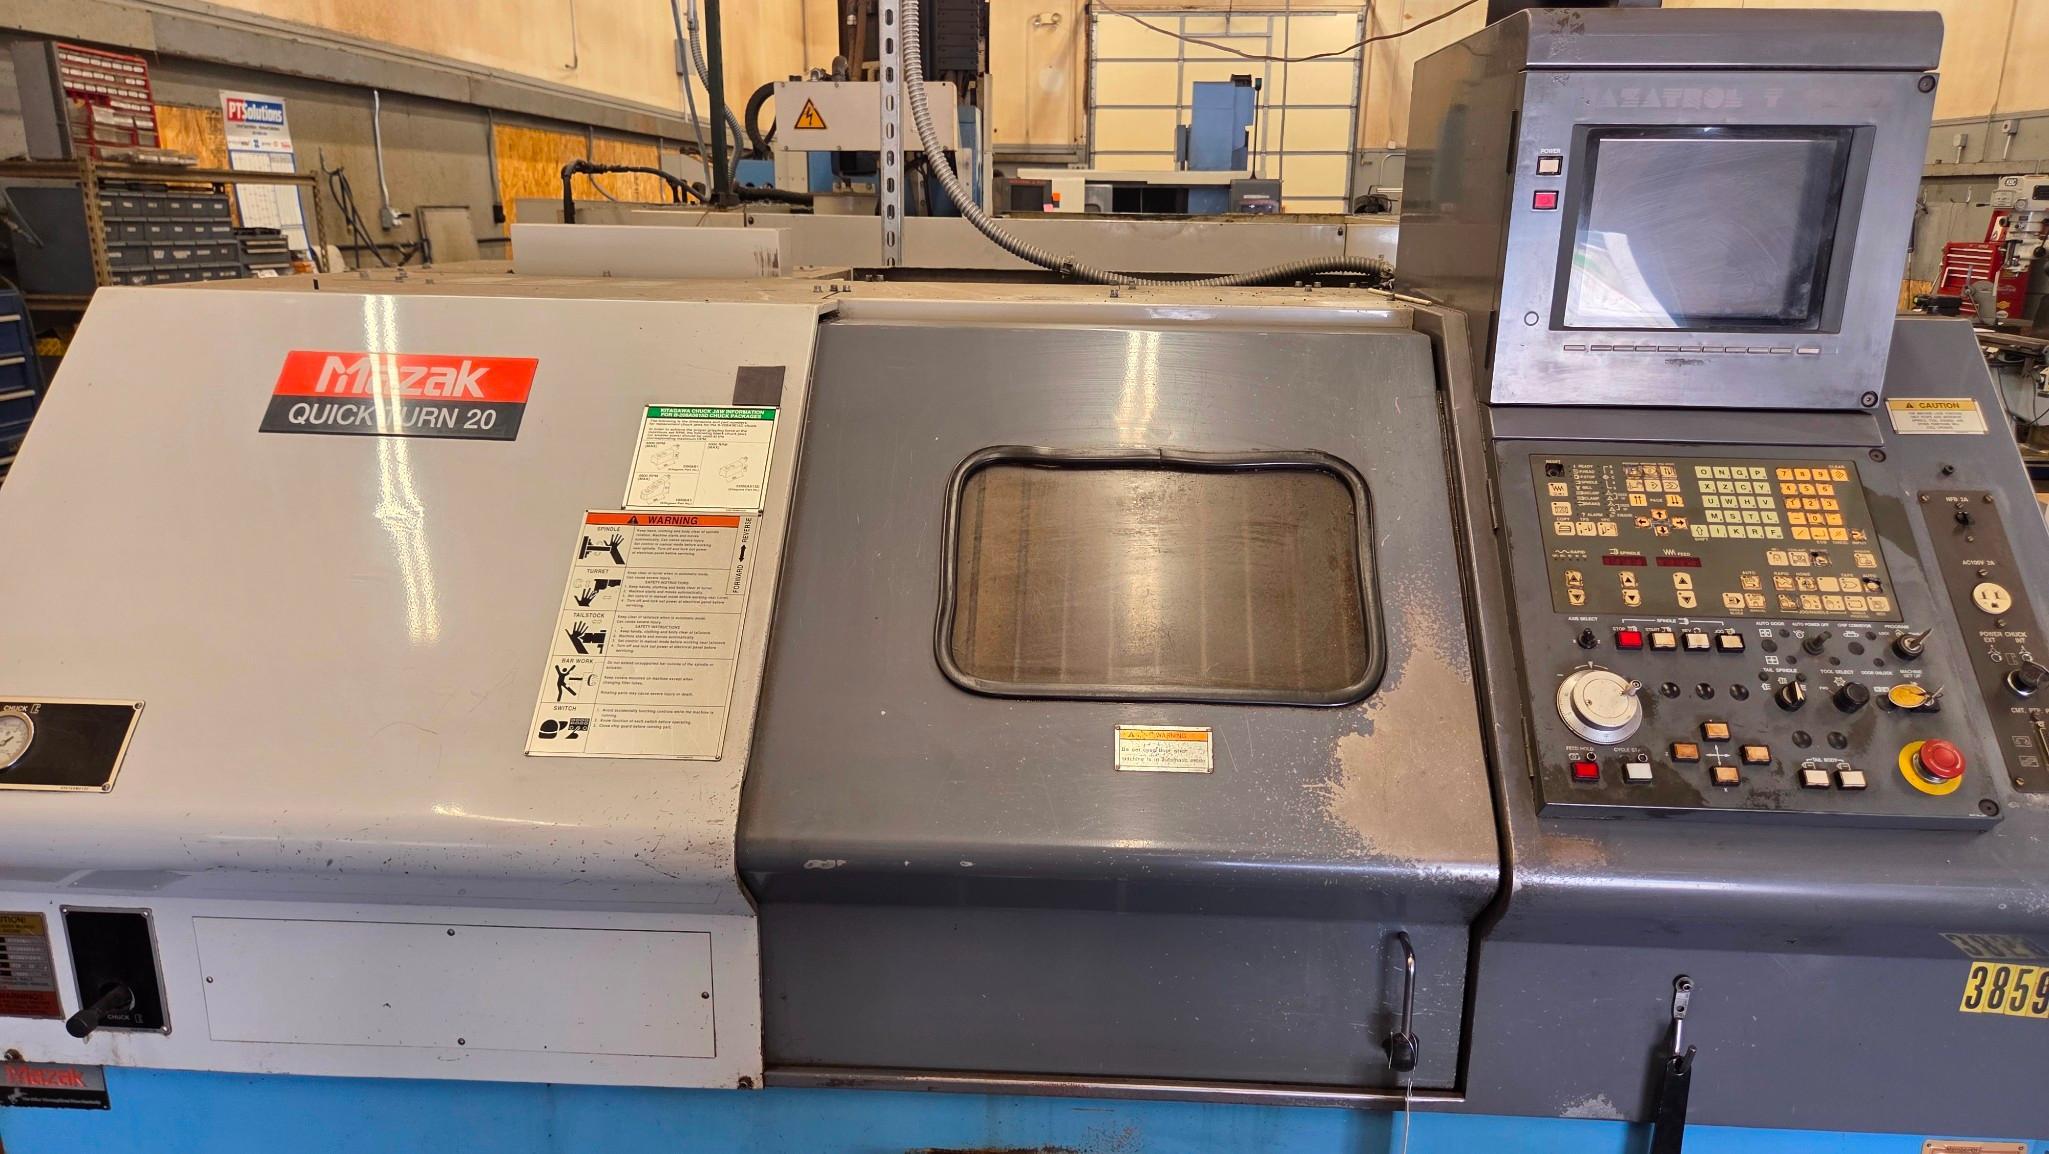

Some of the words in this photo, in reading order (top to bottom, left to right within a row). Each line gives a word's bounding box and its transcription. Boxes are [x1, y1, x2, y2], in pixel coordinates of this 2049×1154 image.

[228, 101, 283, 123] PTSolutions
[314, 355, 492, 398] Mazak
[288, 402, 375, 426] QUICK
[463, 409, 497, 430] 20
[648, 515, 699, 525] WARNING
[741, 517, 752, 543] REVERSE
[732, 564, 744, 593] FORWARD
[2004, 631, 2028, 639] CHUCK
[1964, 966, 2049, 1014] 3859
[4, 1065, 84, 1088] Mazak
